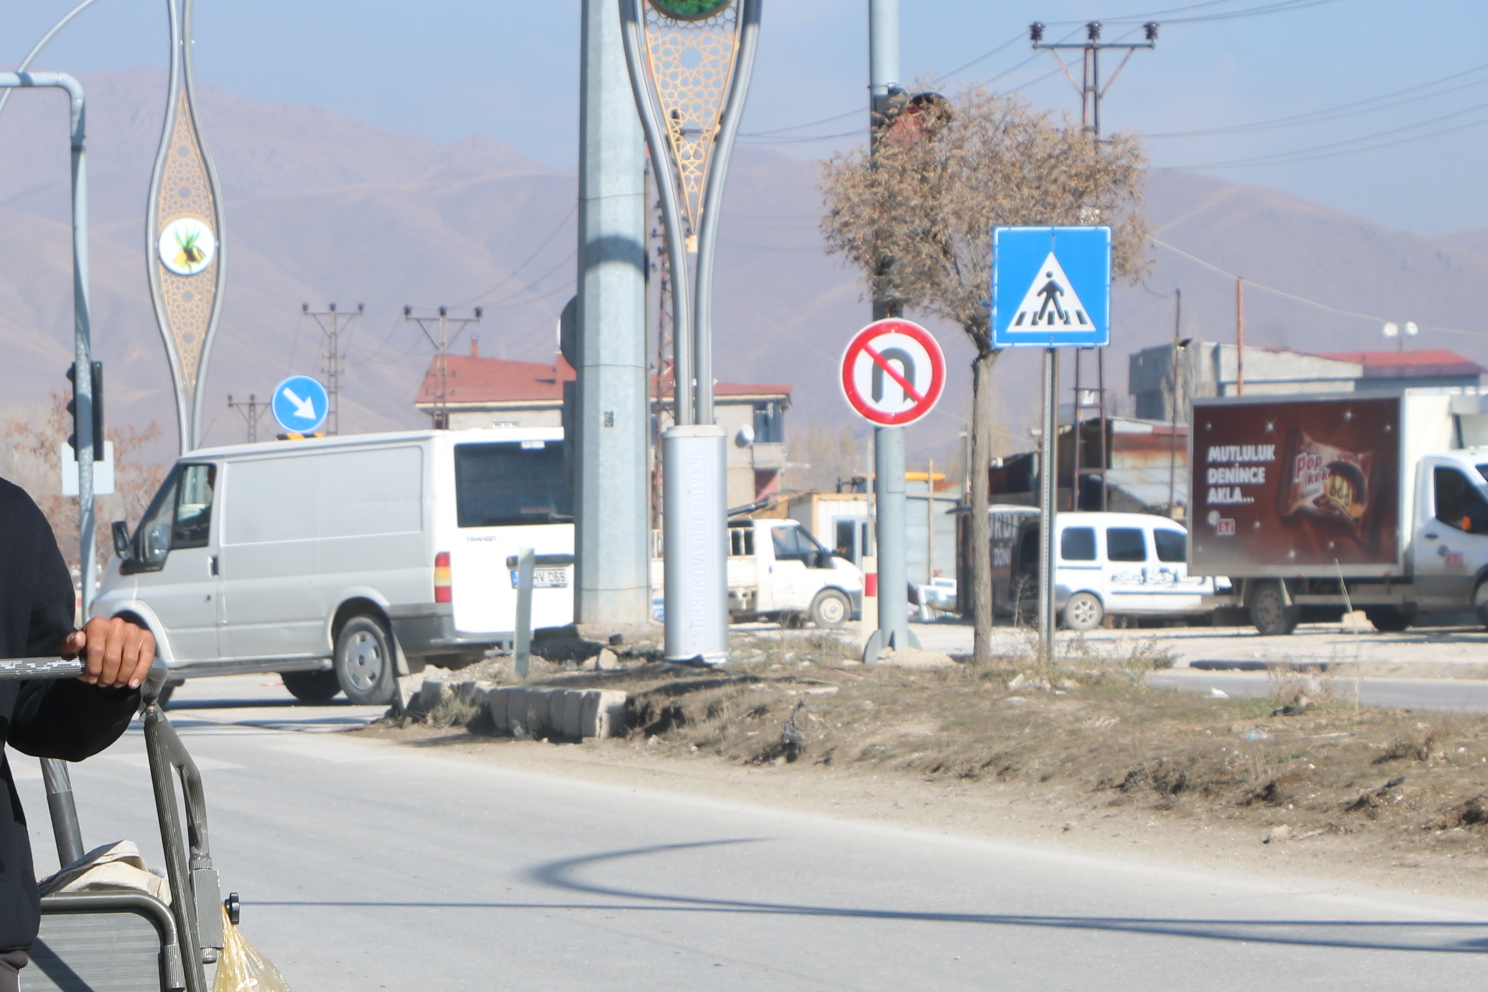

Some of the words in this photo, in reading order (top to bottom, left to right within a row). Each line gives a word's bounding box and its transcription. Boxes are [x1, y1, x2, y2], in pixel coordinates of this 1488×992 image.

[1207, 444, 1277, 462] MUTLULUK
[1206, 463, 1267, 484] DENİNCE
[1206, 486, 1255, 504] AKLA...
